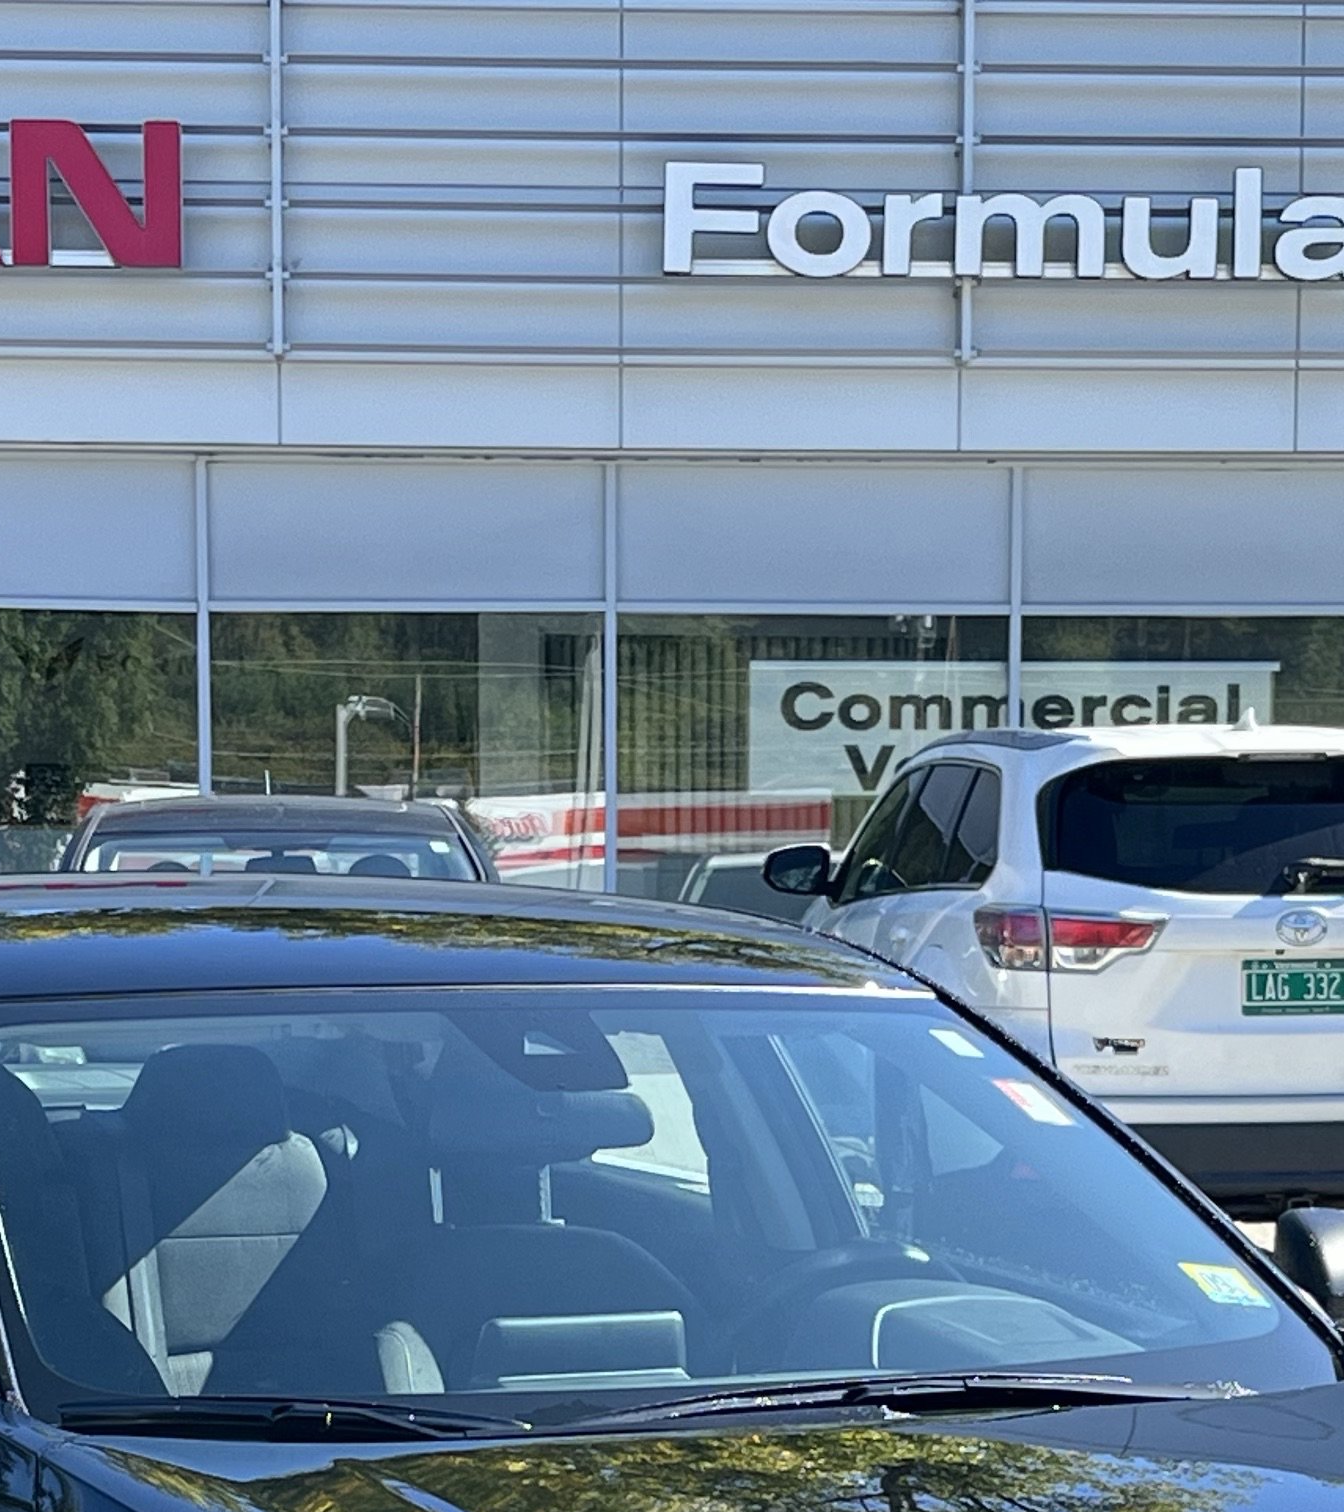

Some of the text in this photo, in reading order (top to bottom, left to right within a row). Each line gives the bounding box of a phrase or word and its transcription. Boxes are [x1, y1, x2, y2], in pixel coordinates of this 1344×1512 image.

[780, 681, 1240, 731] Commercial
[1250, 972, 1342, 1001] LAG 332
